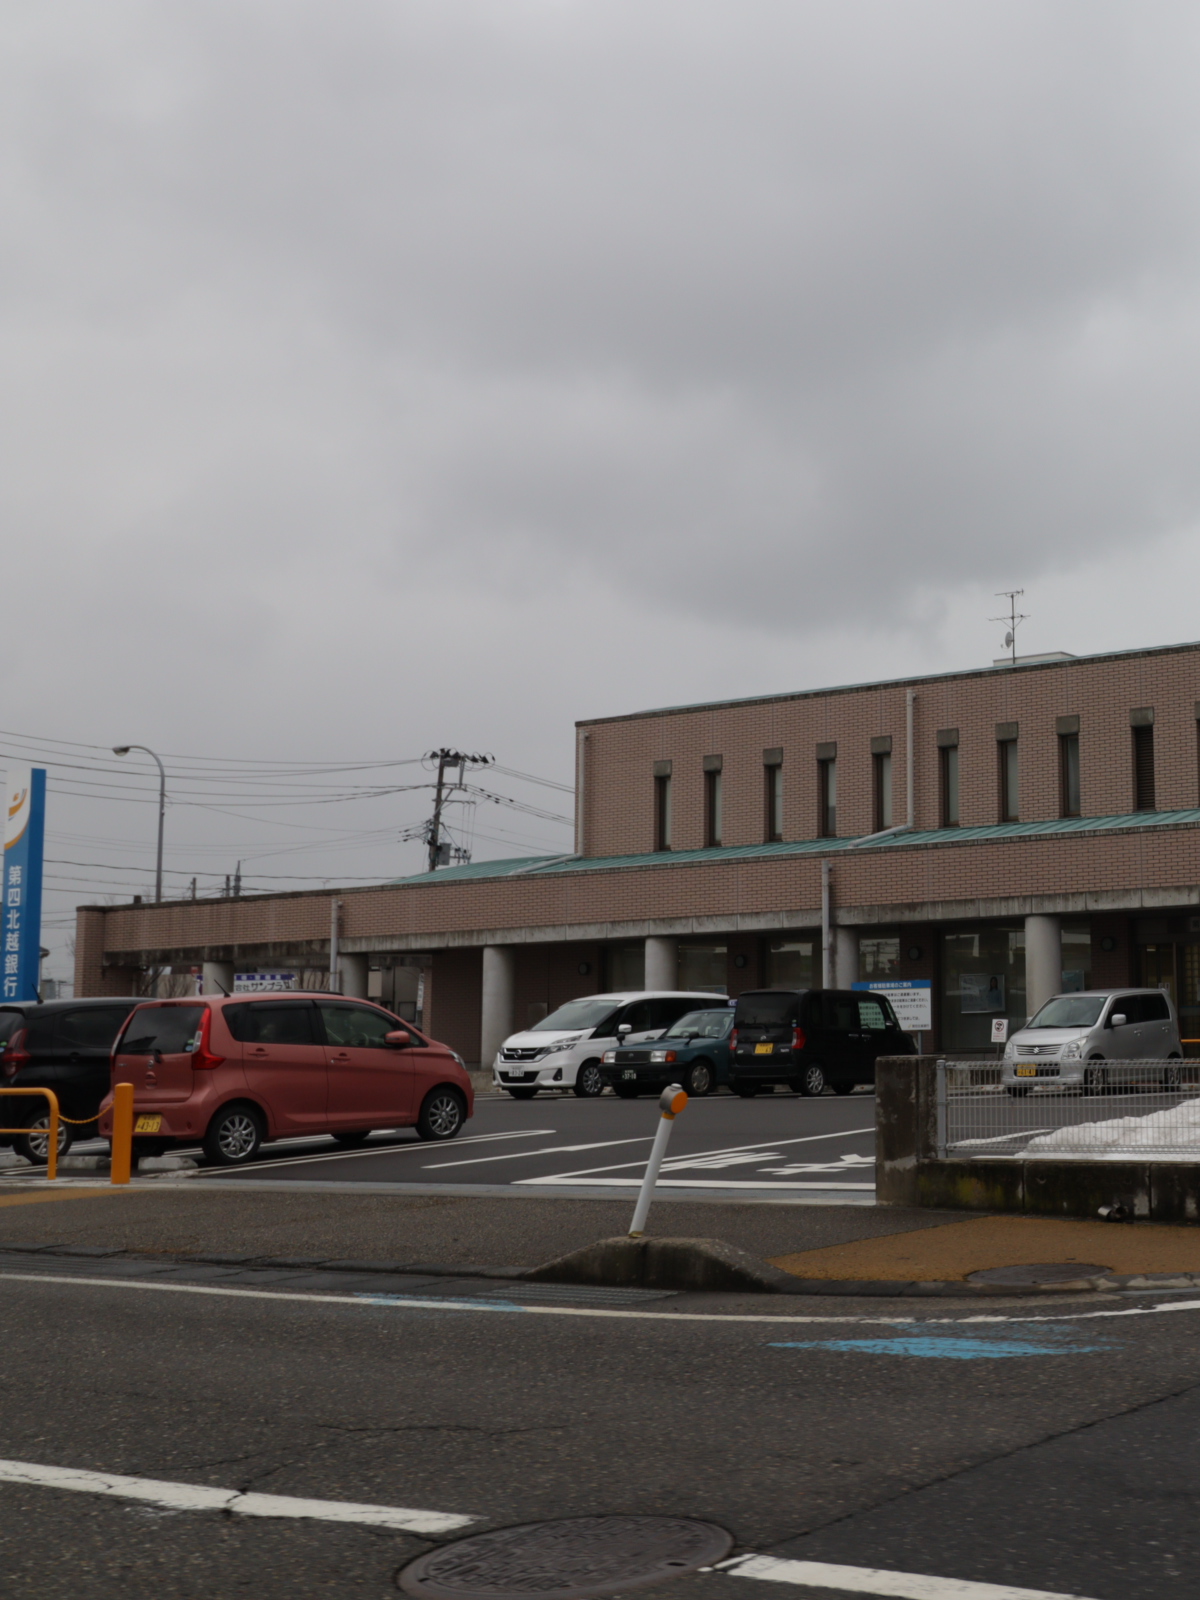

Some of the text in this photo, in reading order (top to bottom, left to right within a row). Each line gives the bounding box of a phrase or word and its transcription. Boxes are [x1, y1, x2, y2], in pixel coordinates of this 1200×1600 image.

[3, 865, 22, 997] 第四北越銀行
